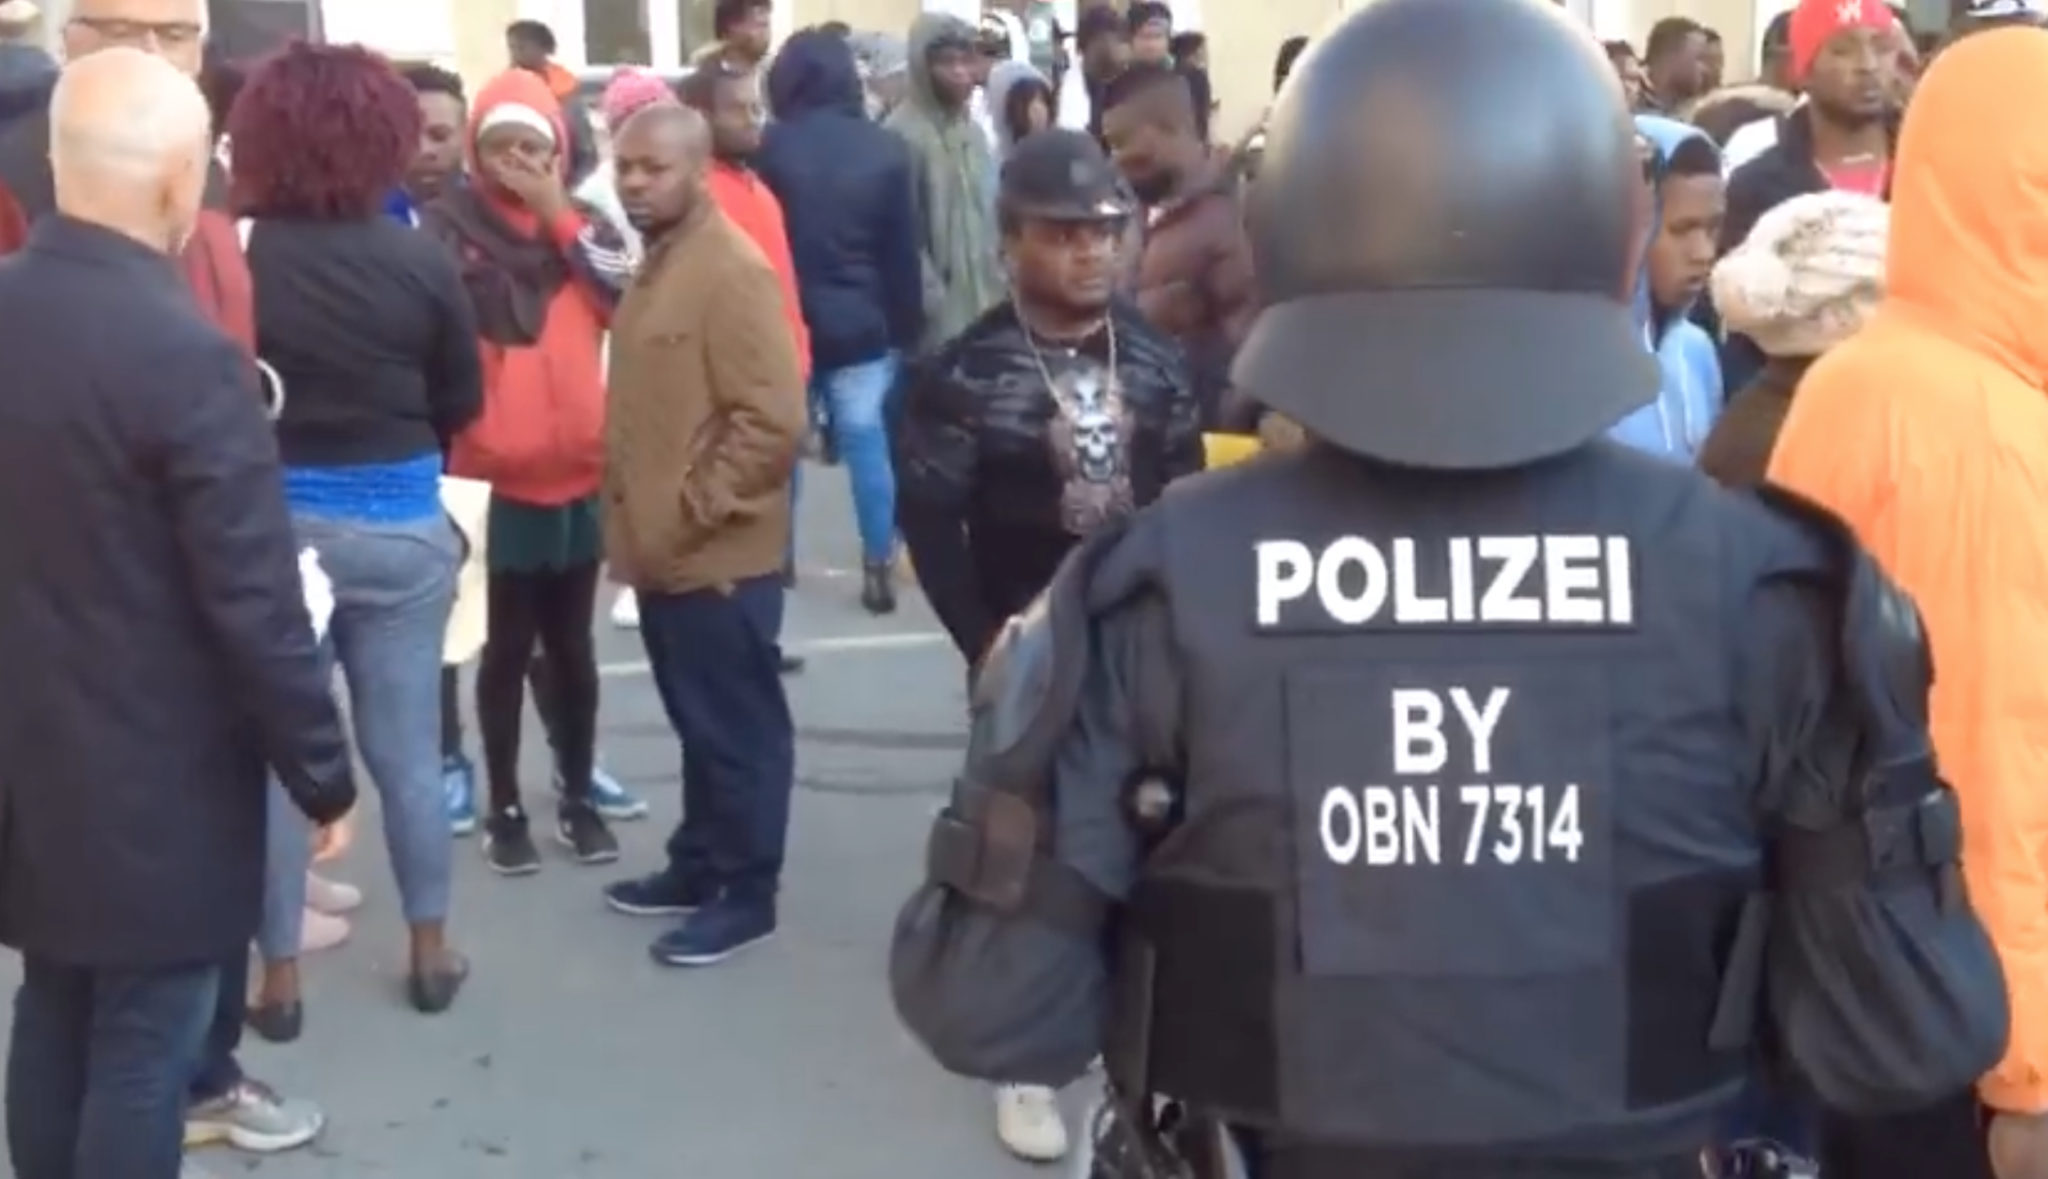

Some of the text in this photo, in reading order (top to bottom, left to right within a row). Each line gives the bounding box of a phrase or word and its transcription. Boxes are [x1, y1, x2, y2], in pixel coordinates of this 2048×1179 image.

[1255, 535, 1632, 625] POLIZEI
[1392, 687, 1510, 774] BY
[1319, 784, 1583, 865] OBN 7314
